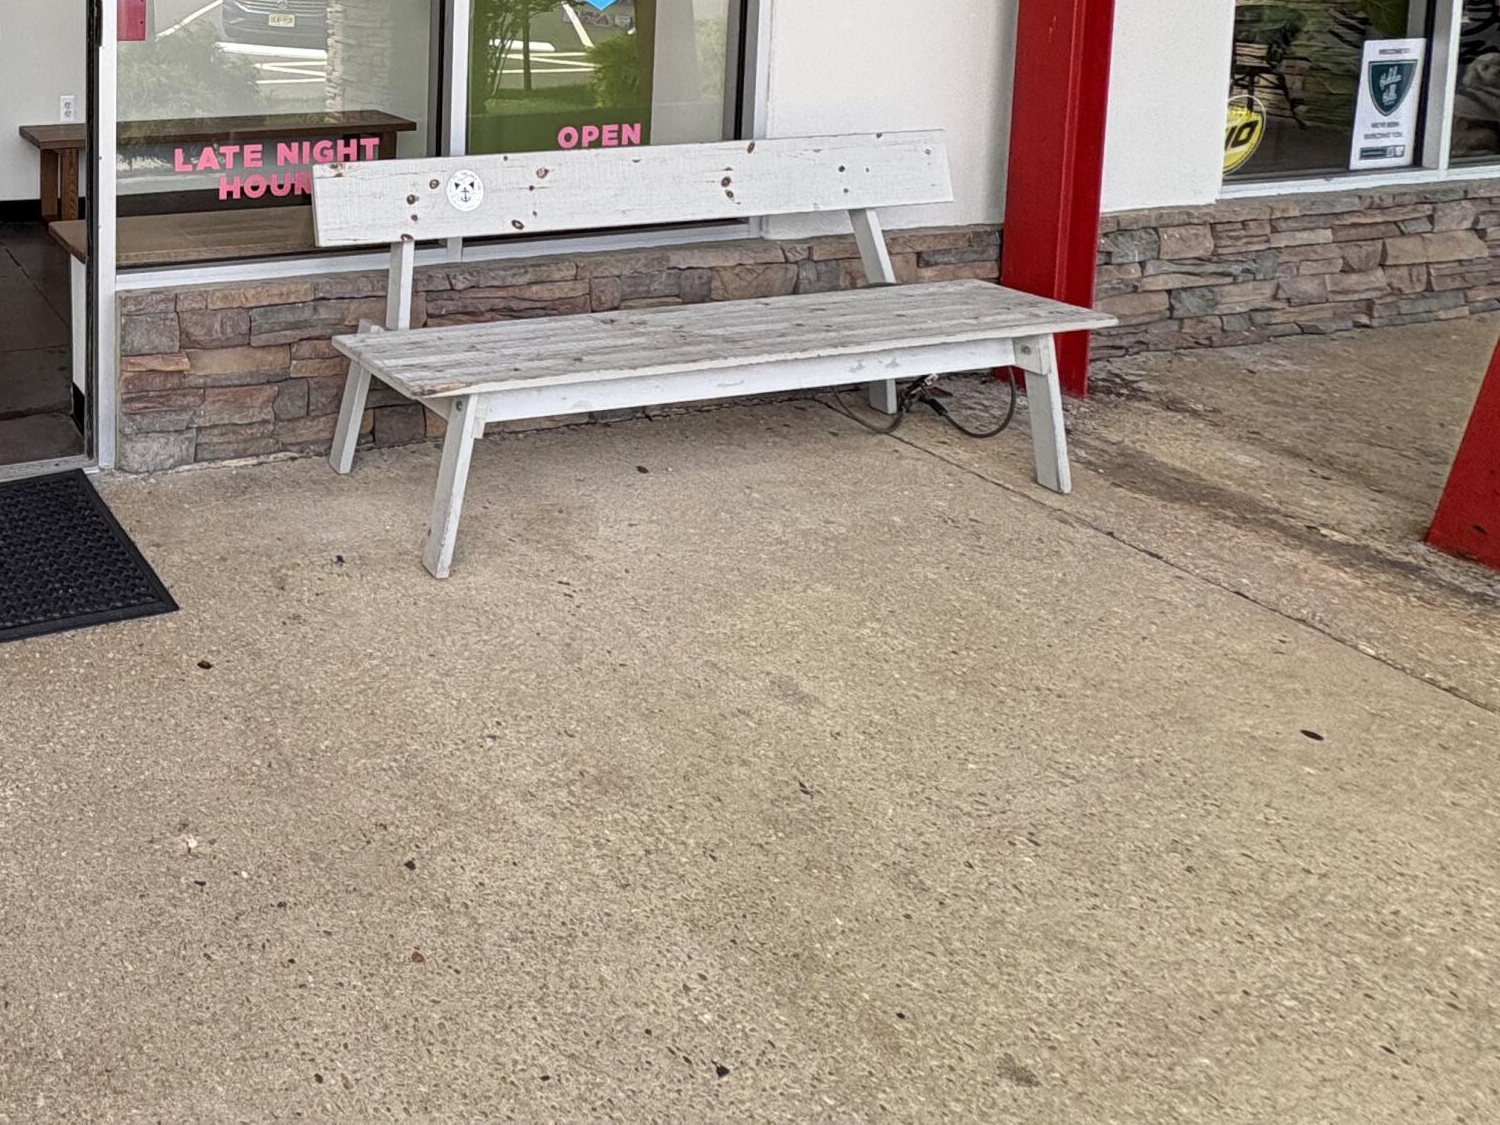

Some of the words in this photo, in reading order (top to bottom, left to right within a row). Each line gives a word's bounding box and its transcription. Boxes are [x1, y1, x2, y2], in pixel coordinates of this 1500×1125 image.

[557, 122, 642, 149] OPEN
[174, 144, 263, 172] LATE
[276, 137, 380, 167] NIGHT
[218, 171, 313, 200] HOUR
